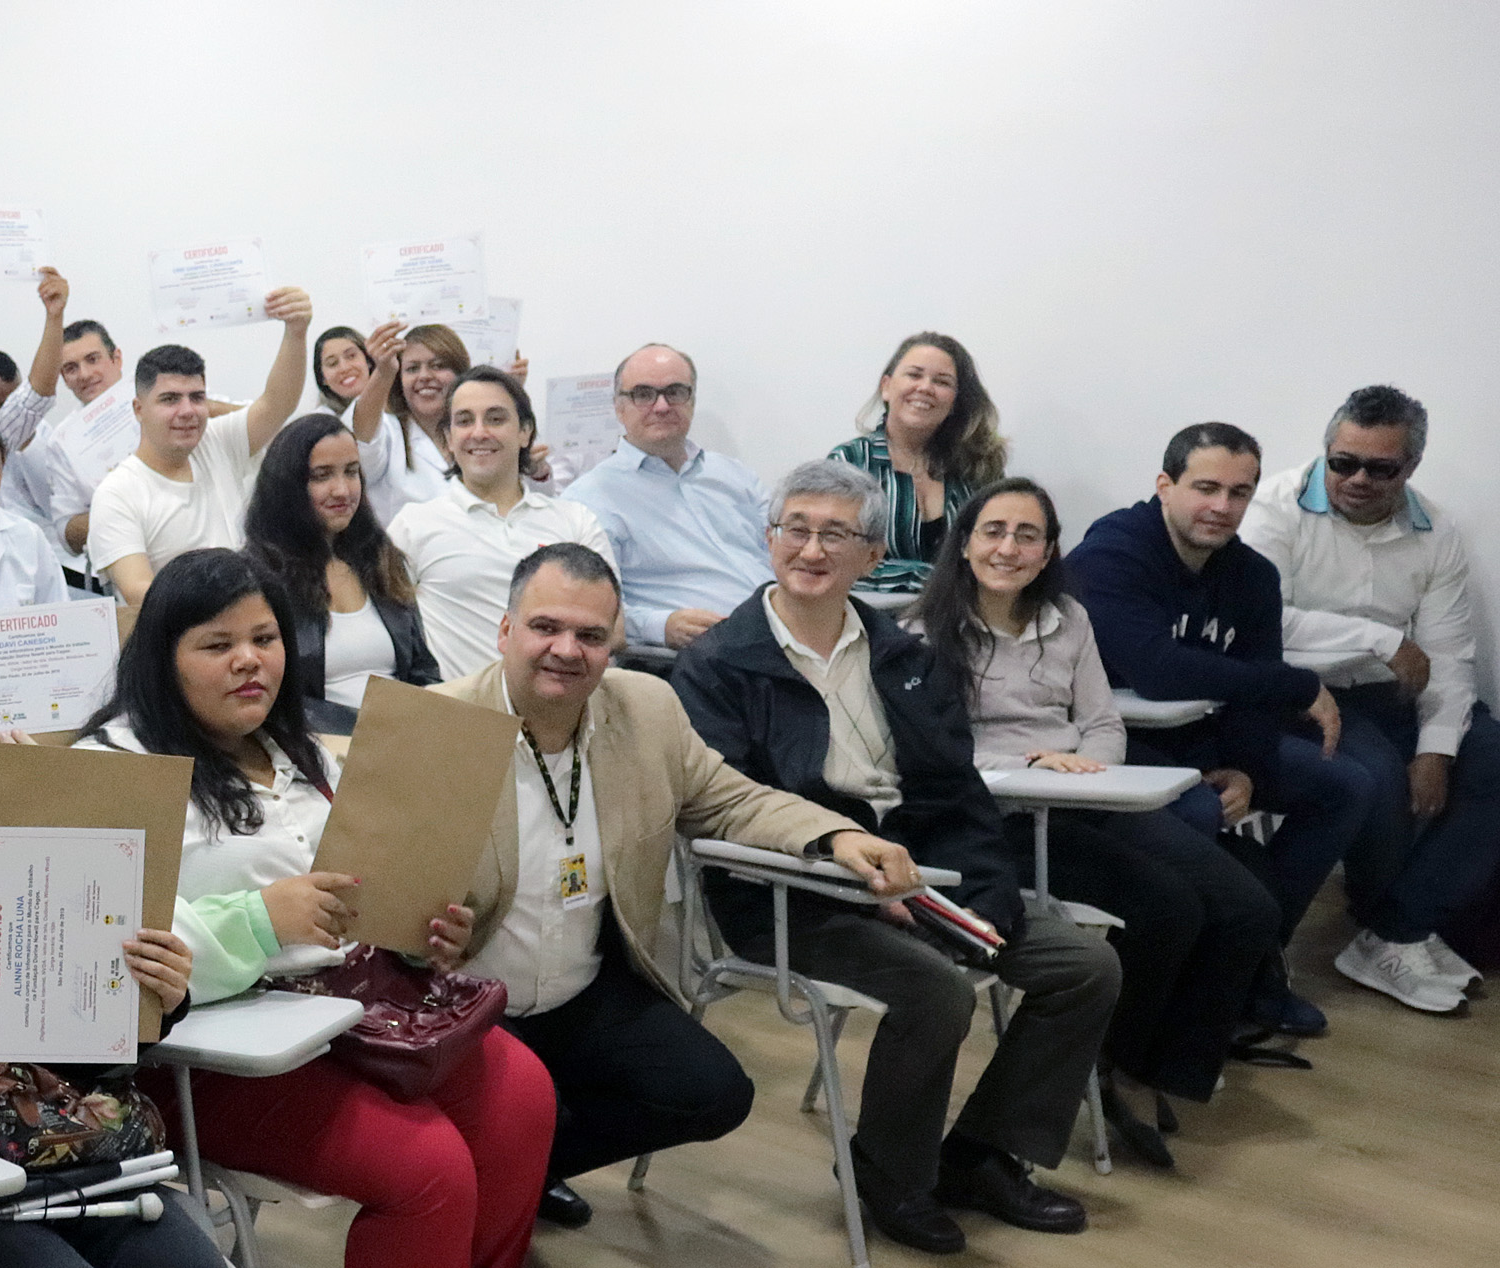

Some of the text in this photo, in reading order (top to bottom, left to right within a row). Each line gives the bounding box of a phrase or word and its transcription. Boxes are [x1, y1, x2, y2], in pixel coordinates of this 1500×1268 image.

[17, 637, 55, 646] CANESCHI
[13, 895, 24, 996] ALINNE ROCHA LUNA
